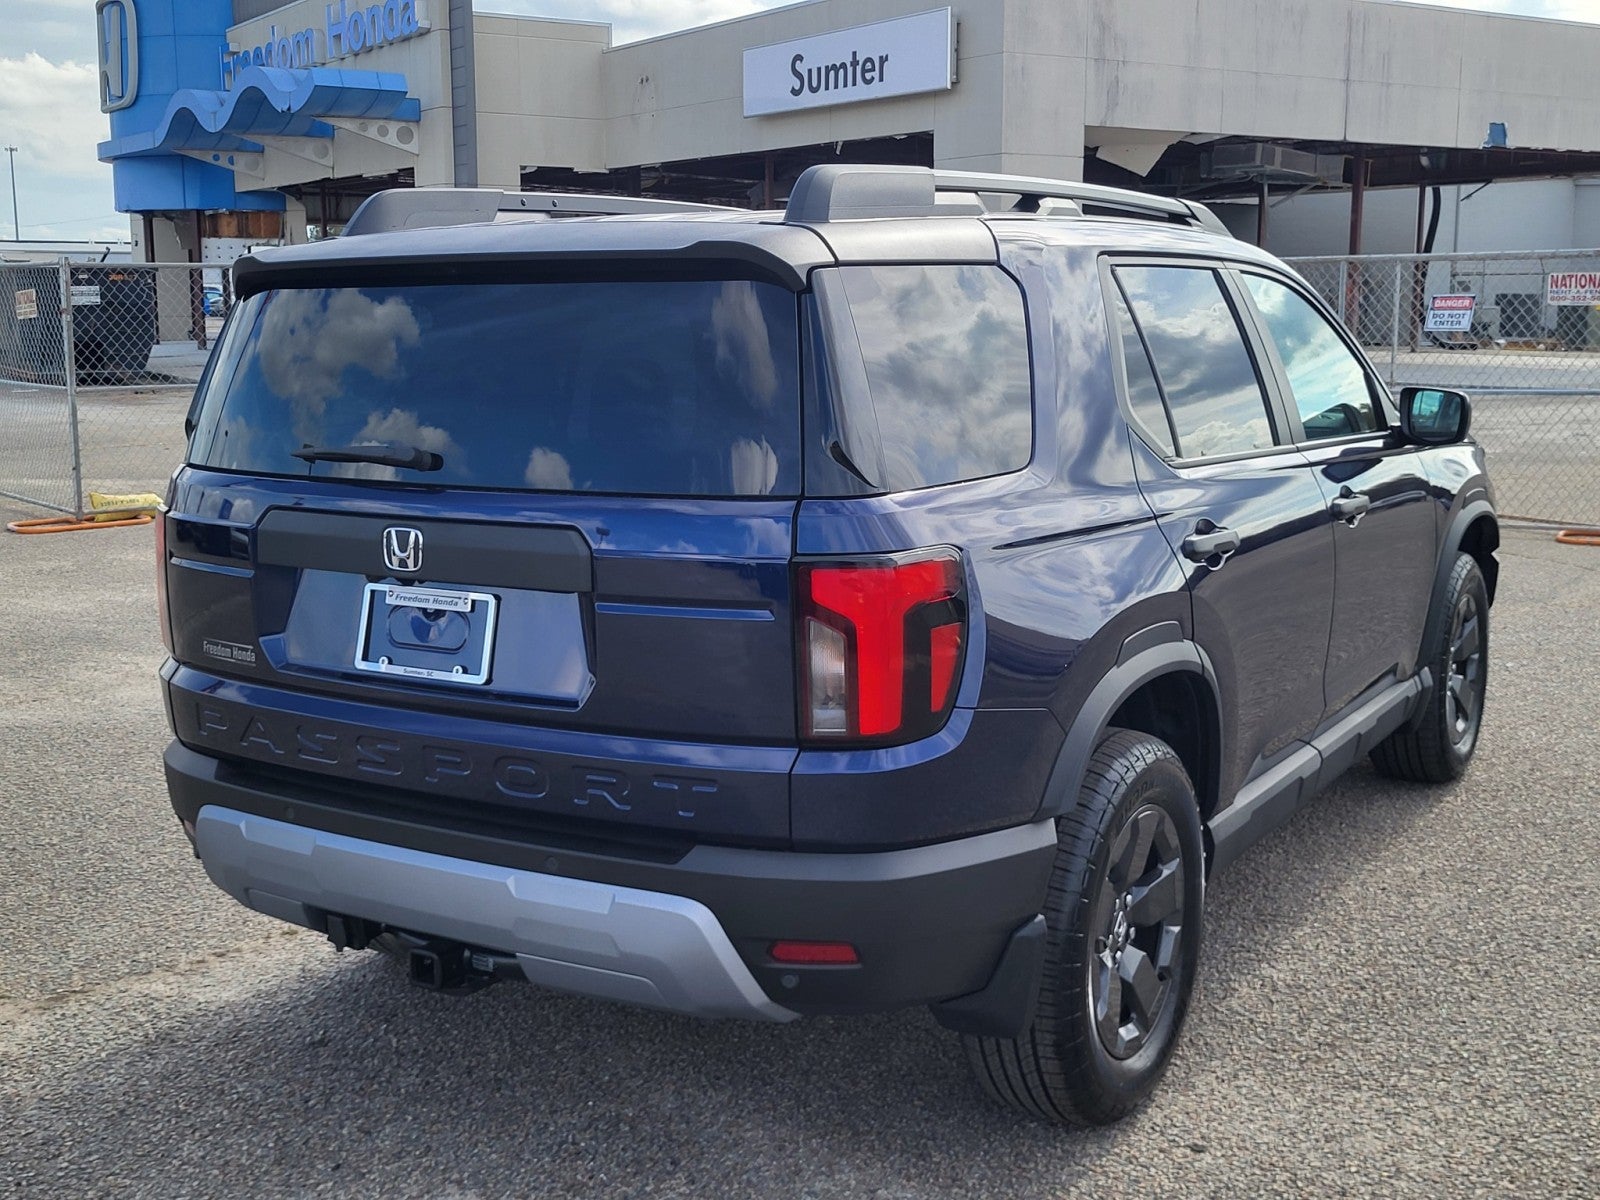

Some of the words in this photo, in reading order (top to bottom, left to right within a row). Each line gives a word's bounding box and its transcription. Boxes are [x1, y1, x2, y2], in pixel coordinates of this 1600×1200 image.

[219, 25, 315, 91] Freedom
[325, 0, 419, 58] Honda
[790, 50, 889, 97] Sumter
[1434, 299, 1471, 308] DANGER
[395, 593, 430, 604] Freedom
[432, 597, 459, 607] Honda
[203, 640, 232, 658] Freedom
[233, 646, 256, 662] Honda
[426, 670, 435, 678] SC
[198, 702, 718, 819] PASSPORT
